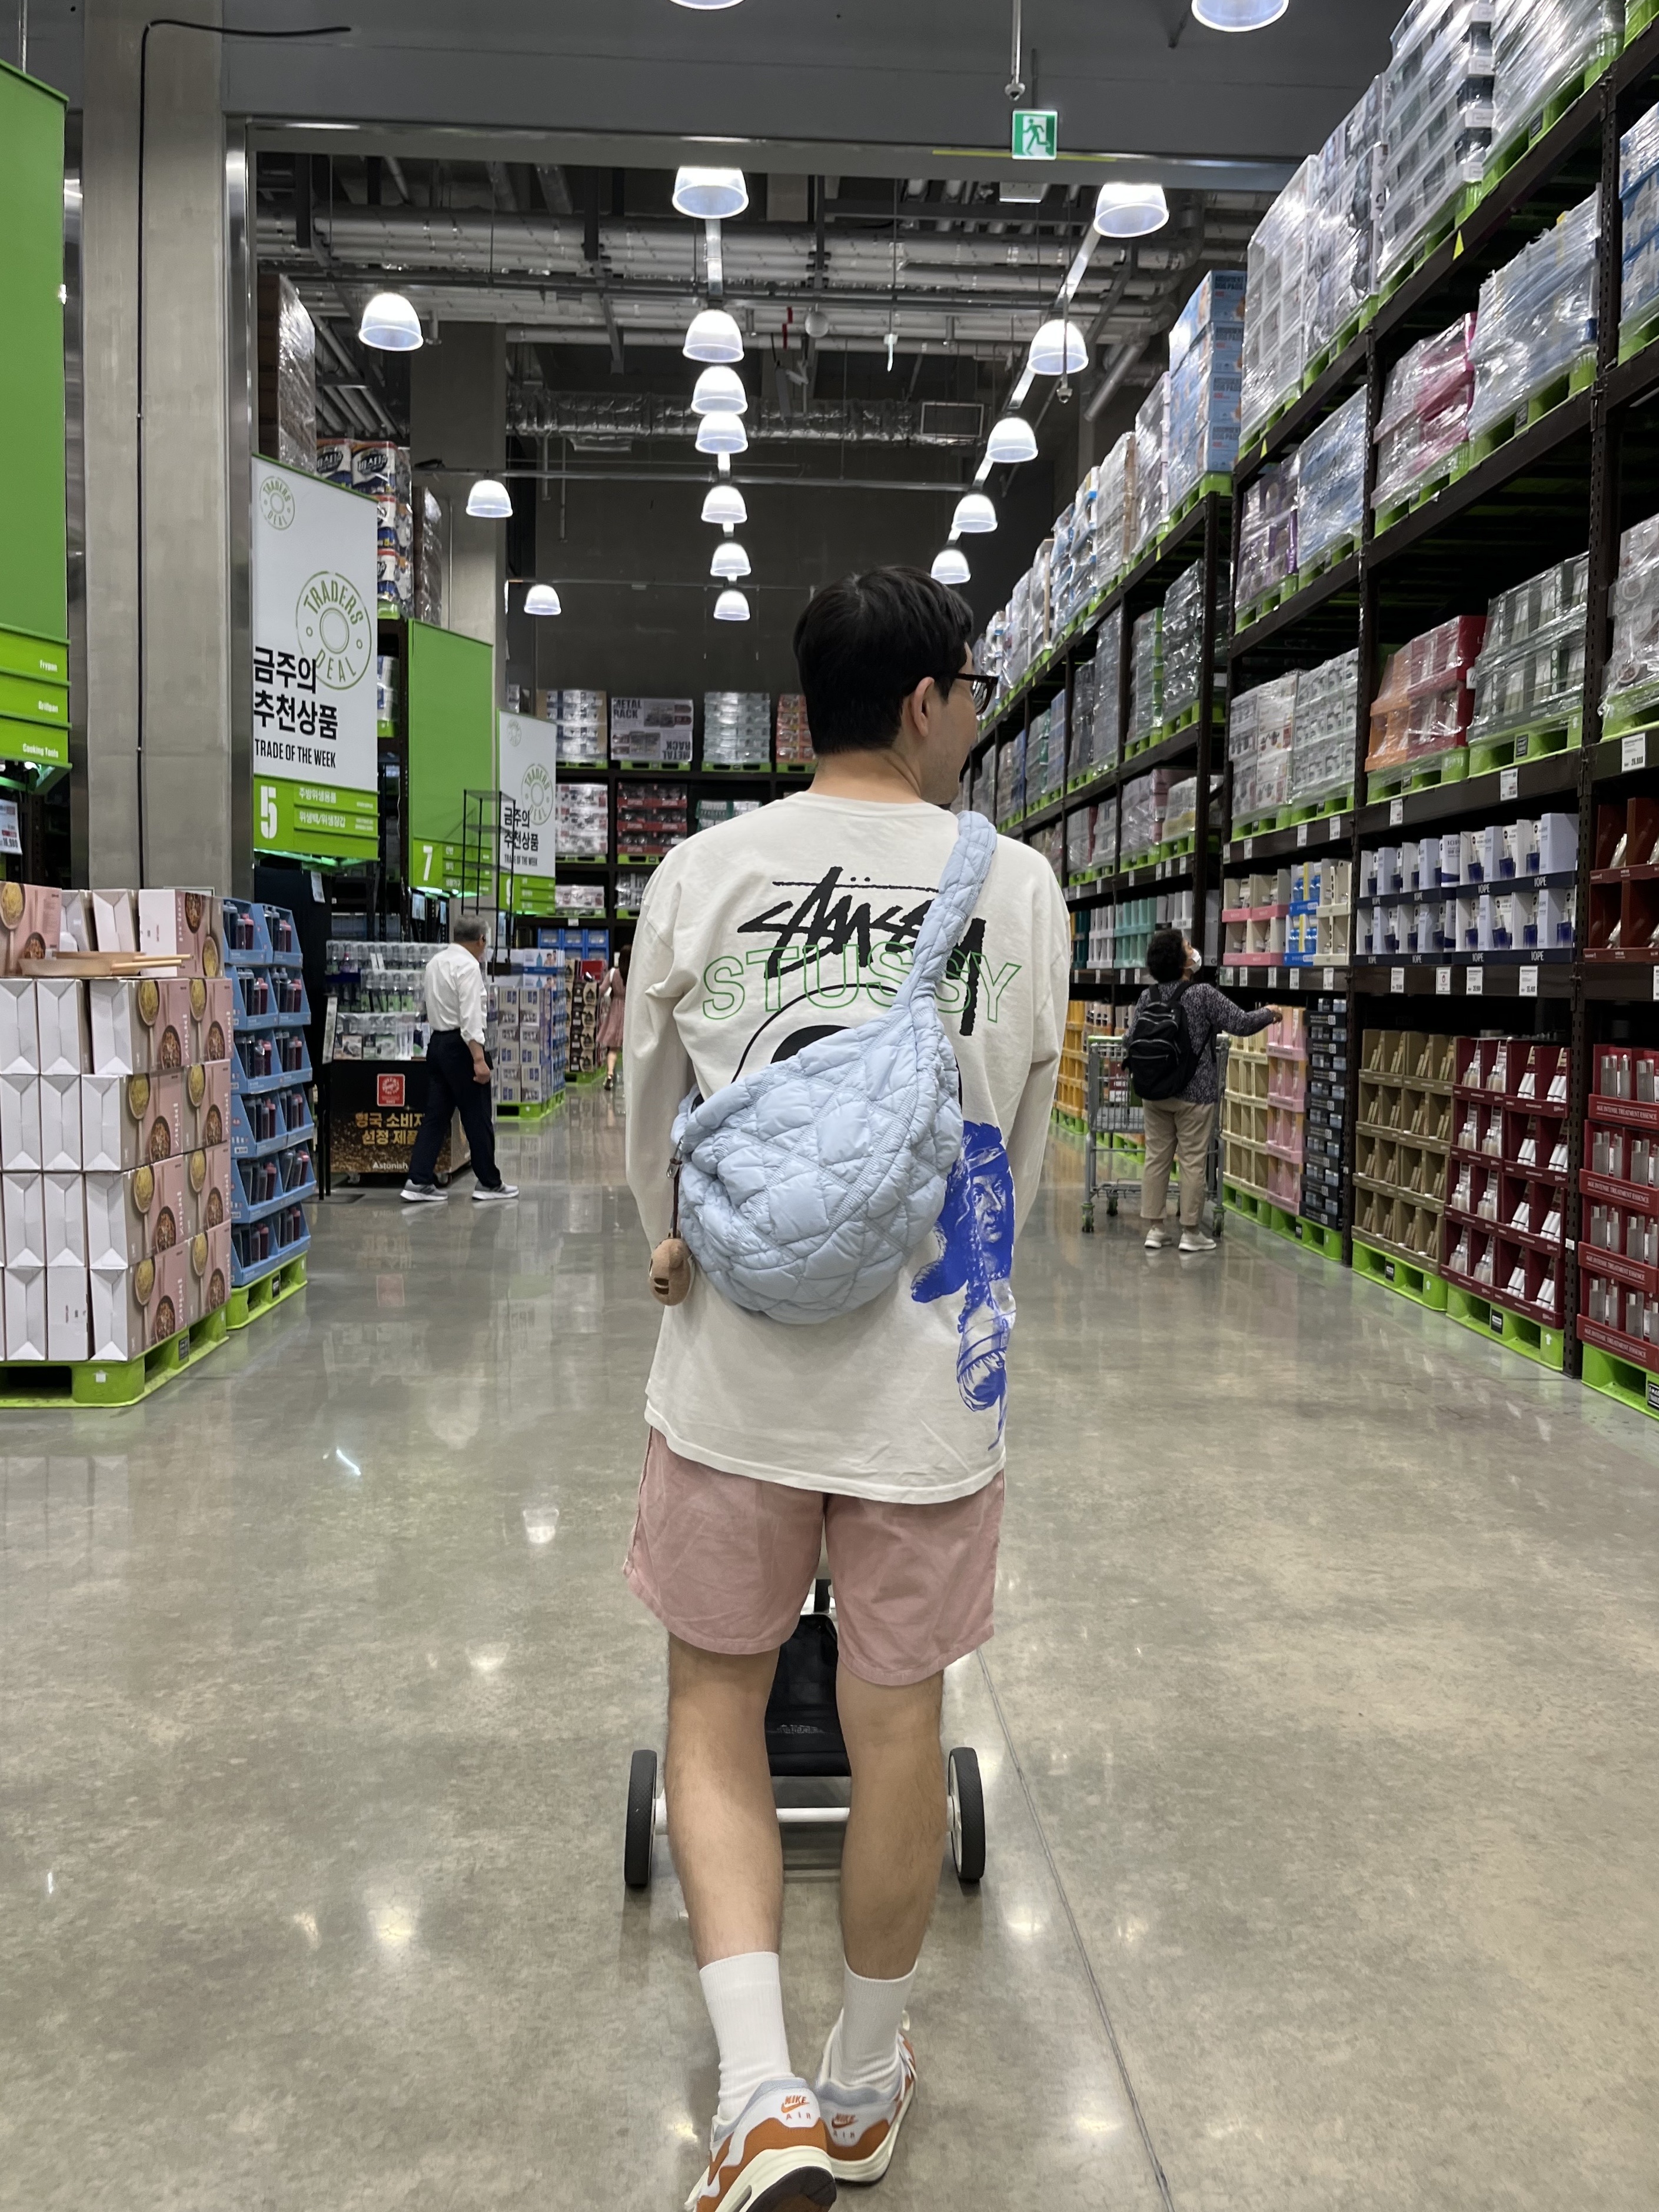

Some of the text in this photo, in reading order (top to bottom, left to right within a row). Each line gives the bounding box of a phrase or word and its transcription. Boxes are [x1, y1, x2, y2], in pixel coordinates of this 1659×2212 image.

[304, 580, 363, 624] TRADERS
[254, 646, 316, 694] 금주의
[315, 648, 356, 683] DEAL
[254, 690, 338, 740] 추천상품
[613, 709, 638, 719] RACK
[255, 739, 336, 769] TRADE OF THE WEEK
[261, 785, 277, 839] 5
[504, 807, 530, 827] 금주의
[504, 831, 538, 851] 추천상품
[423, 845, 433, 881] 7
[1478, 884, 1490, 894] IOPE
[1534, 876, 1547, 887] IOPE
[1472, 953, 1484, 962] IOPE
[1531, 951, 1544, 961] IOPE
[1618, 1108, 1640, 1117] TREATMENT
[1640, 1112, 1657, 1120] ESSENCE
[1610, 1185, 1632, 1198] TREATMENT
[1632, 1192, 1649, 1203] ESSENCE
[1608, 1260, 1628, 1275] TREATMENT
[1607, 1335, 1628, 1351] TREATMENT
[785, 2095, 807, 2104] NIKE
[786, 2111, 812, 2120] AIR
[836, 2113, 856, 2122] NIKE
[833, 2130, 856, 2138] AIR
